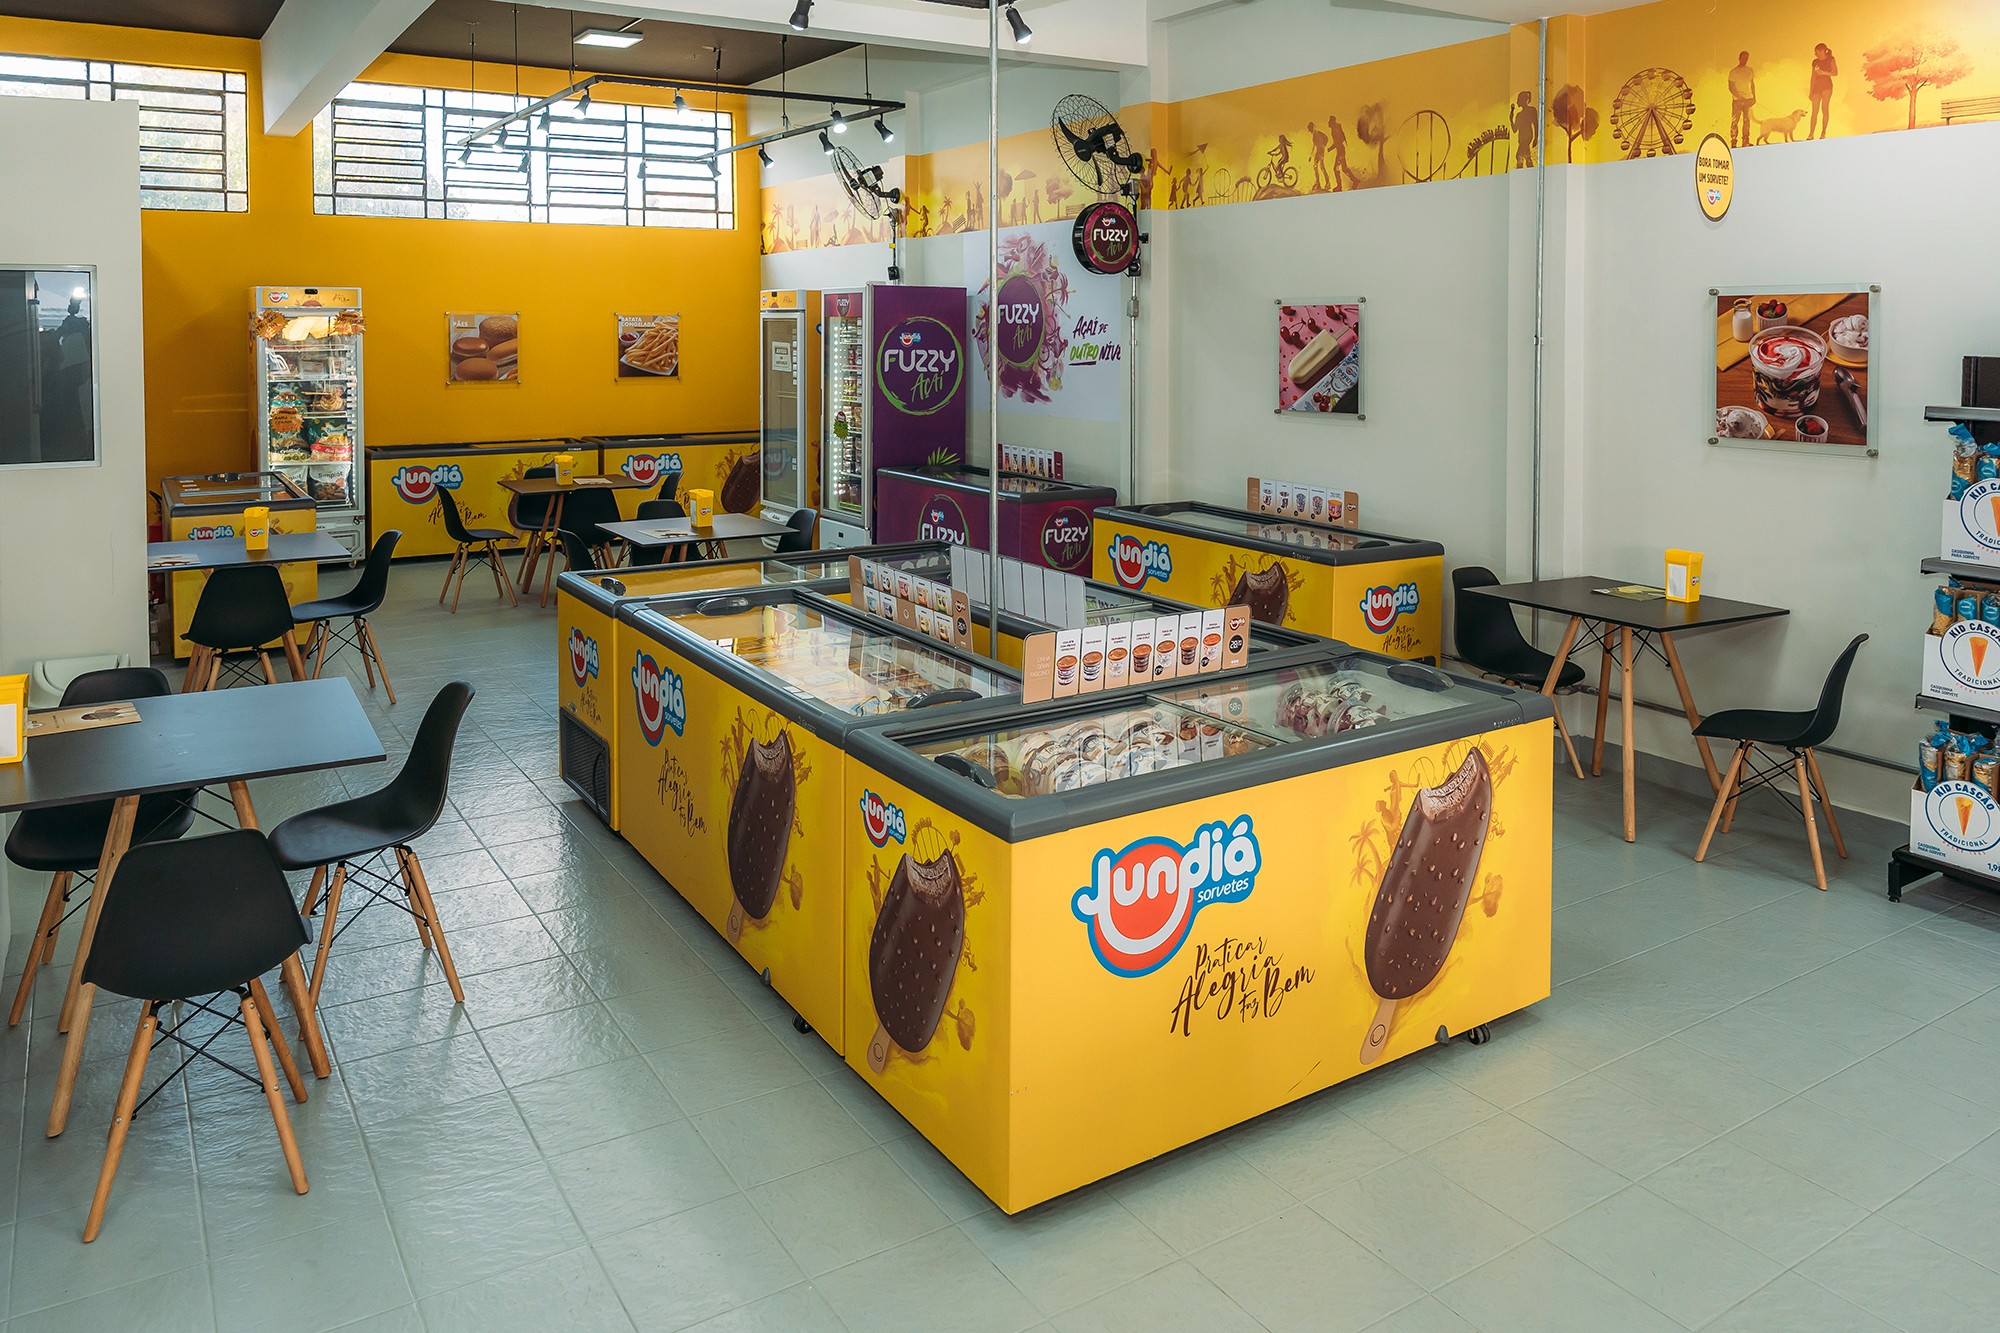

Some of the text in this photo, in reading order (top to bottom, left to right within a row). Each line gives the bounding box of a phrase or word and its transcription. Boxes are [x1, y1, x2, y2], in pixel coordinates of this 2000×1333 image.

[1699, 157, 1730, 170] BORA TOMAR
[1698, 173, 1706, 182] UM
[1093, 228, 1129, 242] FUZZY
[998, 303, 1040, 325] FUZZY
[884, 349, 956, 373] FUZZY
[1069, 343, 1099, 361] OUTRO
[318, 471, 343, 479] Simplot
[622, 453, 682, 484] Jundiá
[393, 466, 462, 498] Jundiá
[1969, 484, 1987, 500] KID
[189, 526, 233, 540] Jundiá
[1045, 526, 1088, 545] FUZZY
[1109, 536, 1171, 584] Jundiá
[1361, 585, 1418, 626] Jundiá
[1949, 624, 1966, 639] KID
[568, 629, 598, 678] Jundiá
[633, 653, 685, 731] Jundiá
[1934, 783, 1995, 811] KID CASCÃO
[861, 790, 905, 839] Jundiá
[1940, 828, 1988, 848] TRADICIONAL
[1077, 821, 1257, 955] Jundiá
[1197, 877, 1249, 903] sorvetes
[1195, 936, 1268, 980] Praticar
[1170, 953, 1285, 1037] Alegria
[1238, 966, 1316, 1023] Faz Bem
